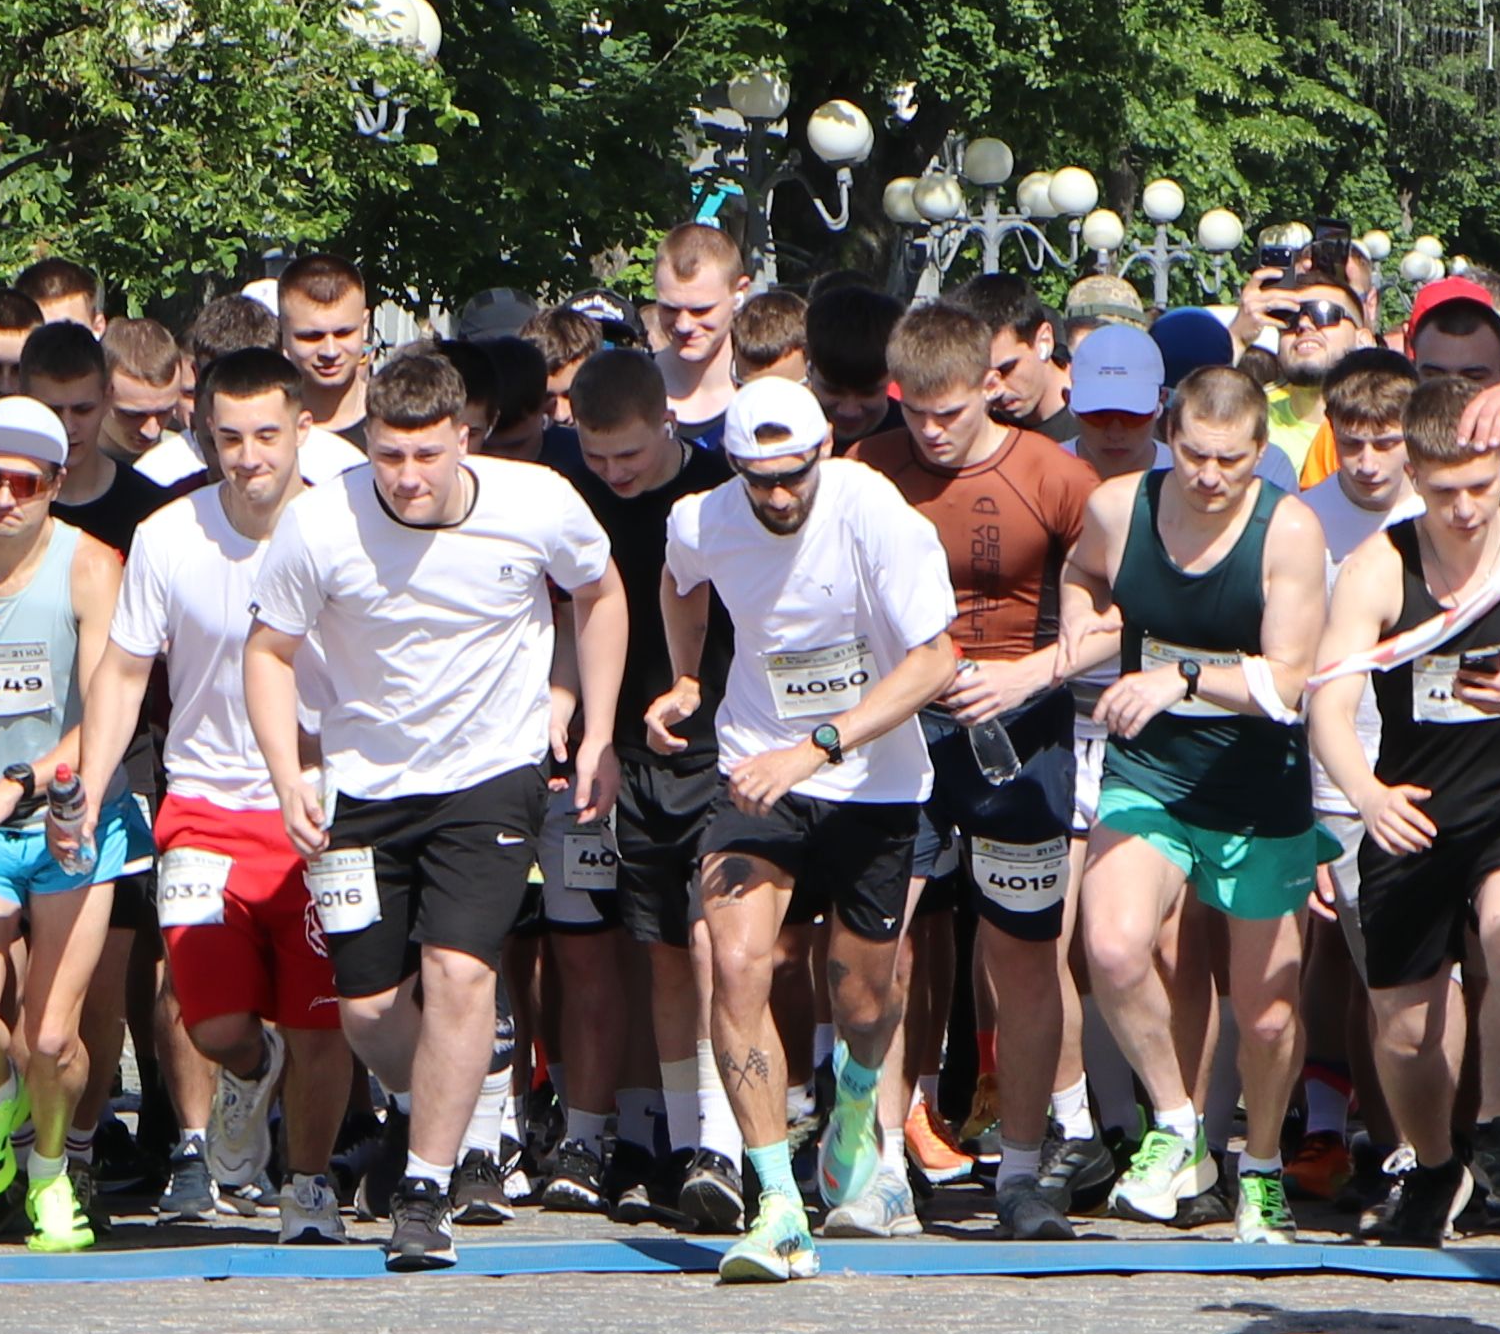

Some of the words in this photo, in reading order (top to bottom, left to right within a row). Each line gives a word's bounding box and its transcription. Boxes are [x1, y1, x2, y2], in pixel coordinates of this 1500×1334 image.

[986, 524, 1001, 612] DEFD
[971, 524, 986, 642] YOUELF
[786, 670, 869, 696] 4050
[160, 883, 211, 903] 032
[988, 873, 1058, 891] 4019
